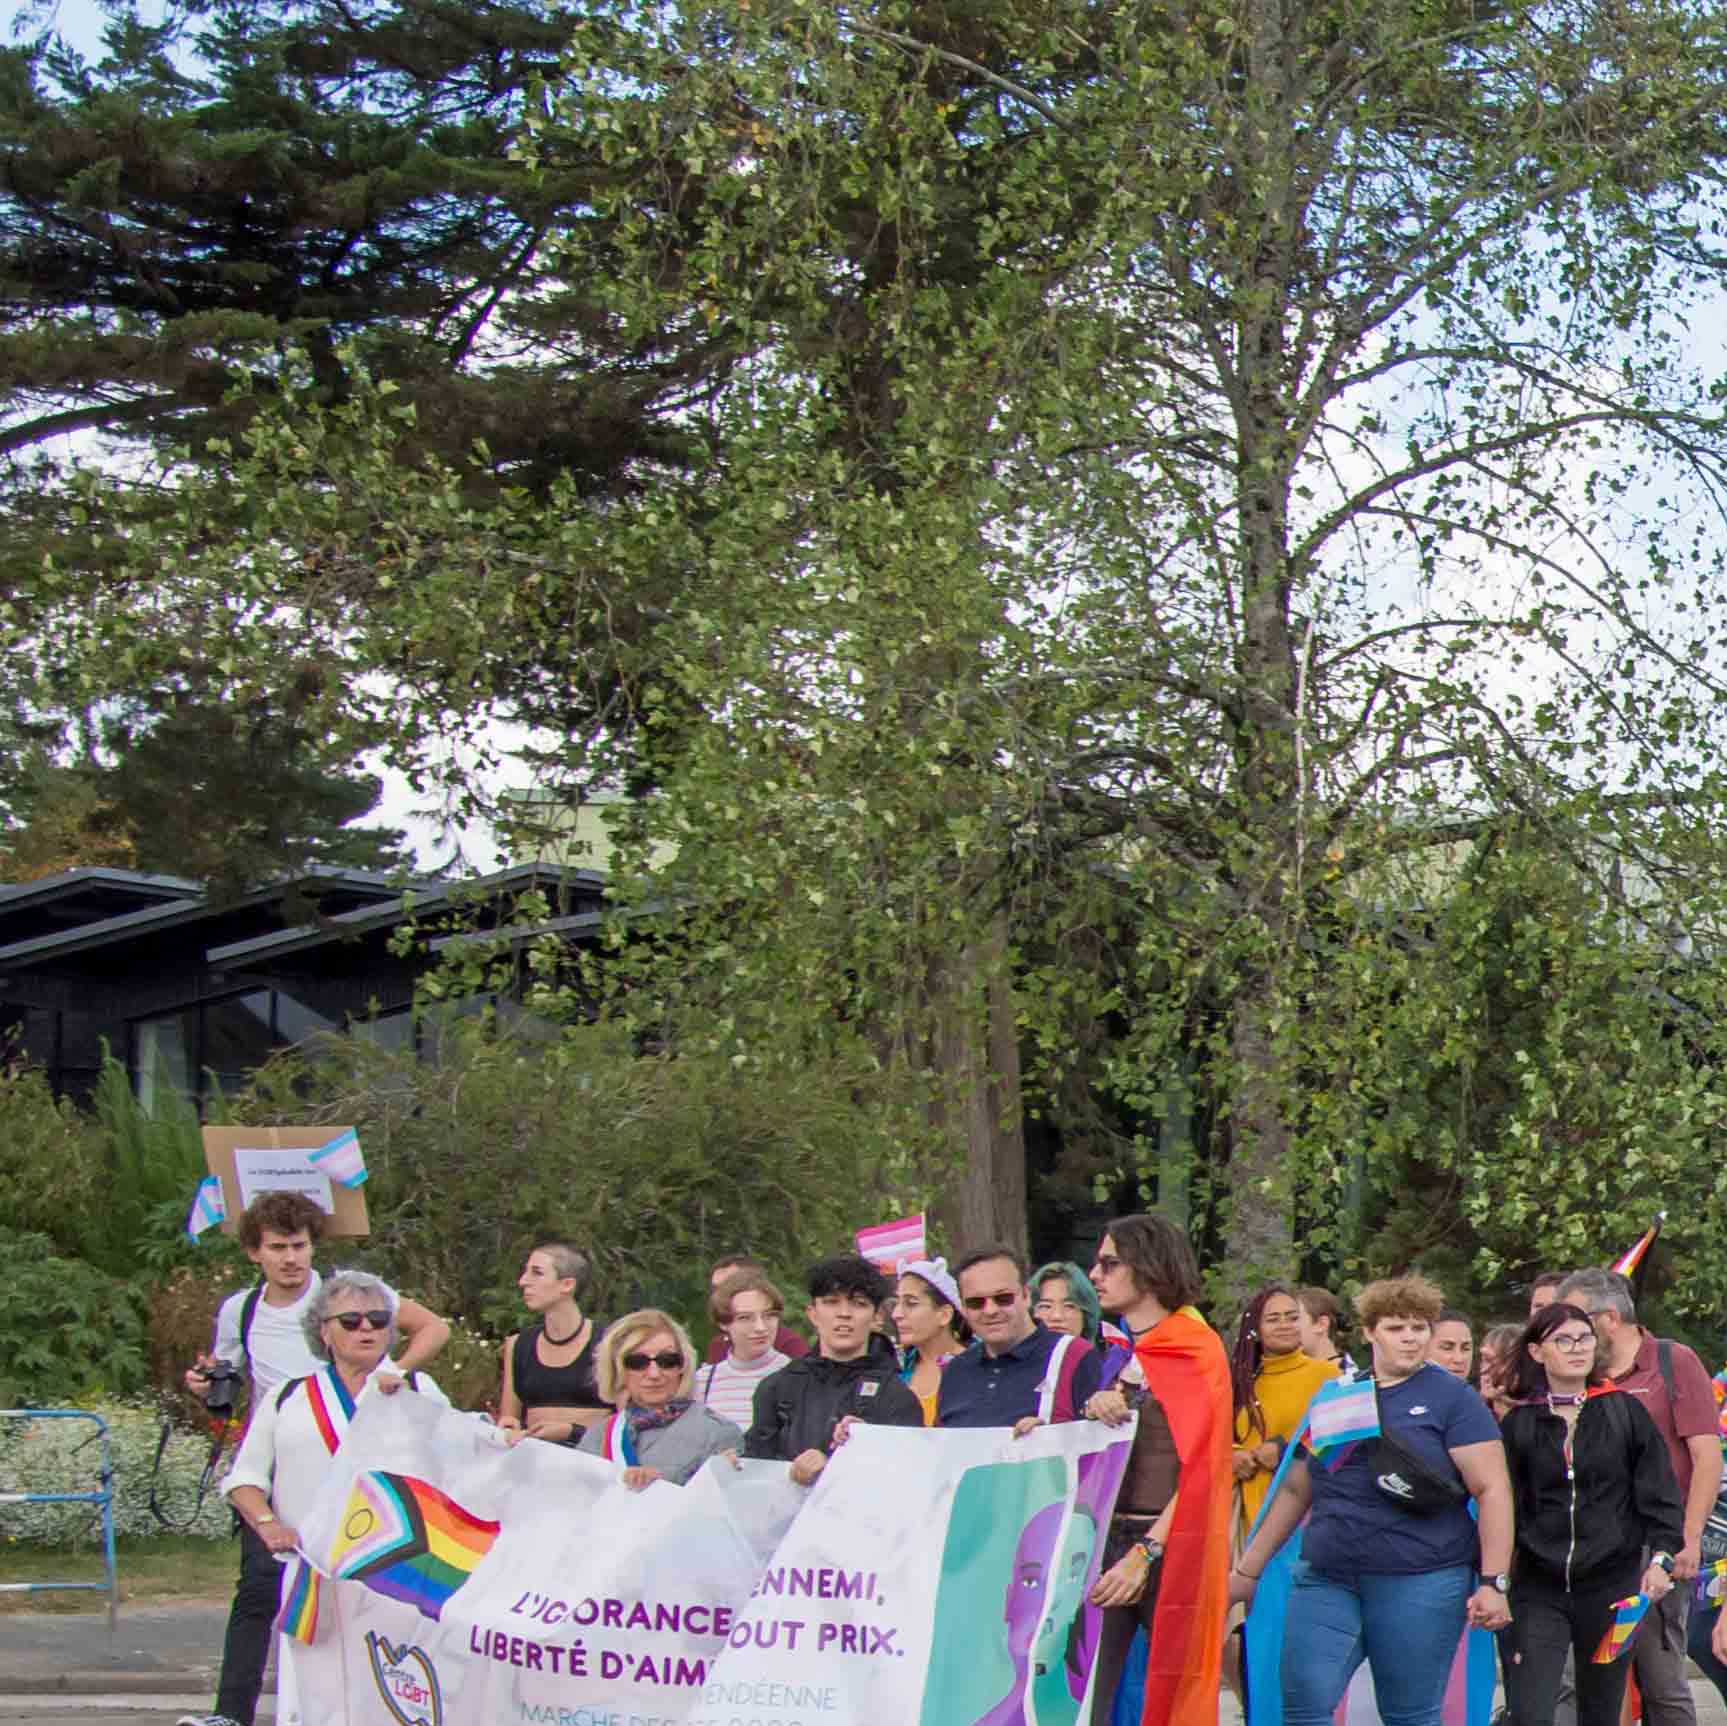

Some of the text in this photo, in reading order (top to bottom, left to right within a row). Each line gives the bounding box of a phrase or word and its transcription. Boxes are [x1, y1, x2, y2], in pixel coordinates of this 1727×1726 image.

[470, 1624, 588, 1677] LIBERTÉ
[817, 1623, 905, 1656] PRIX.
[394, 1680, 430, 1706] LGBT
